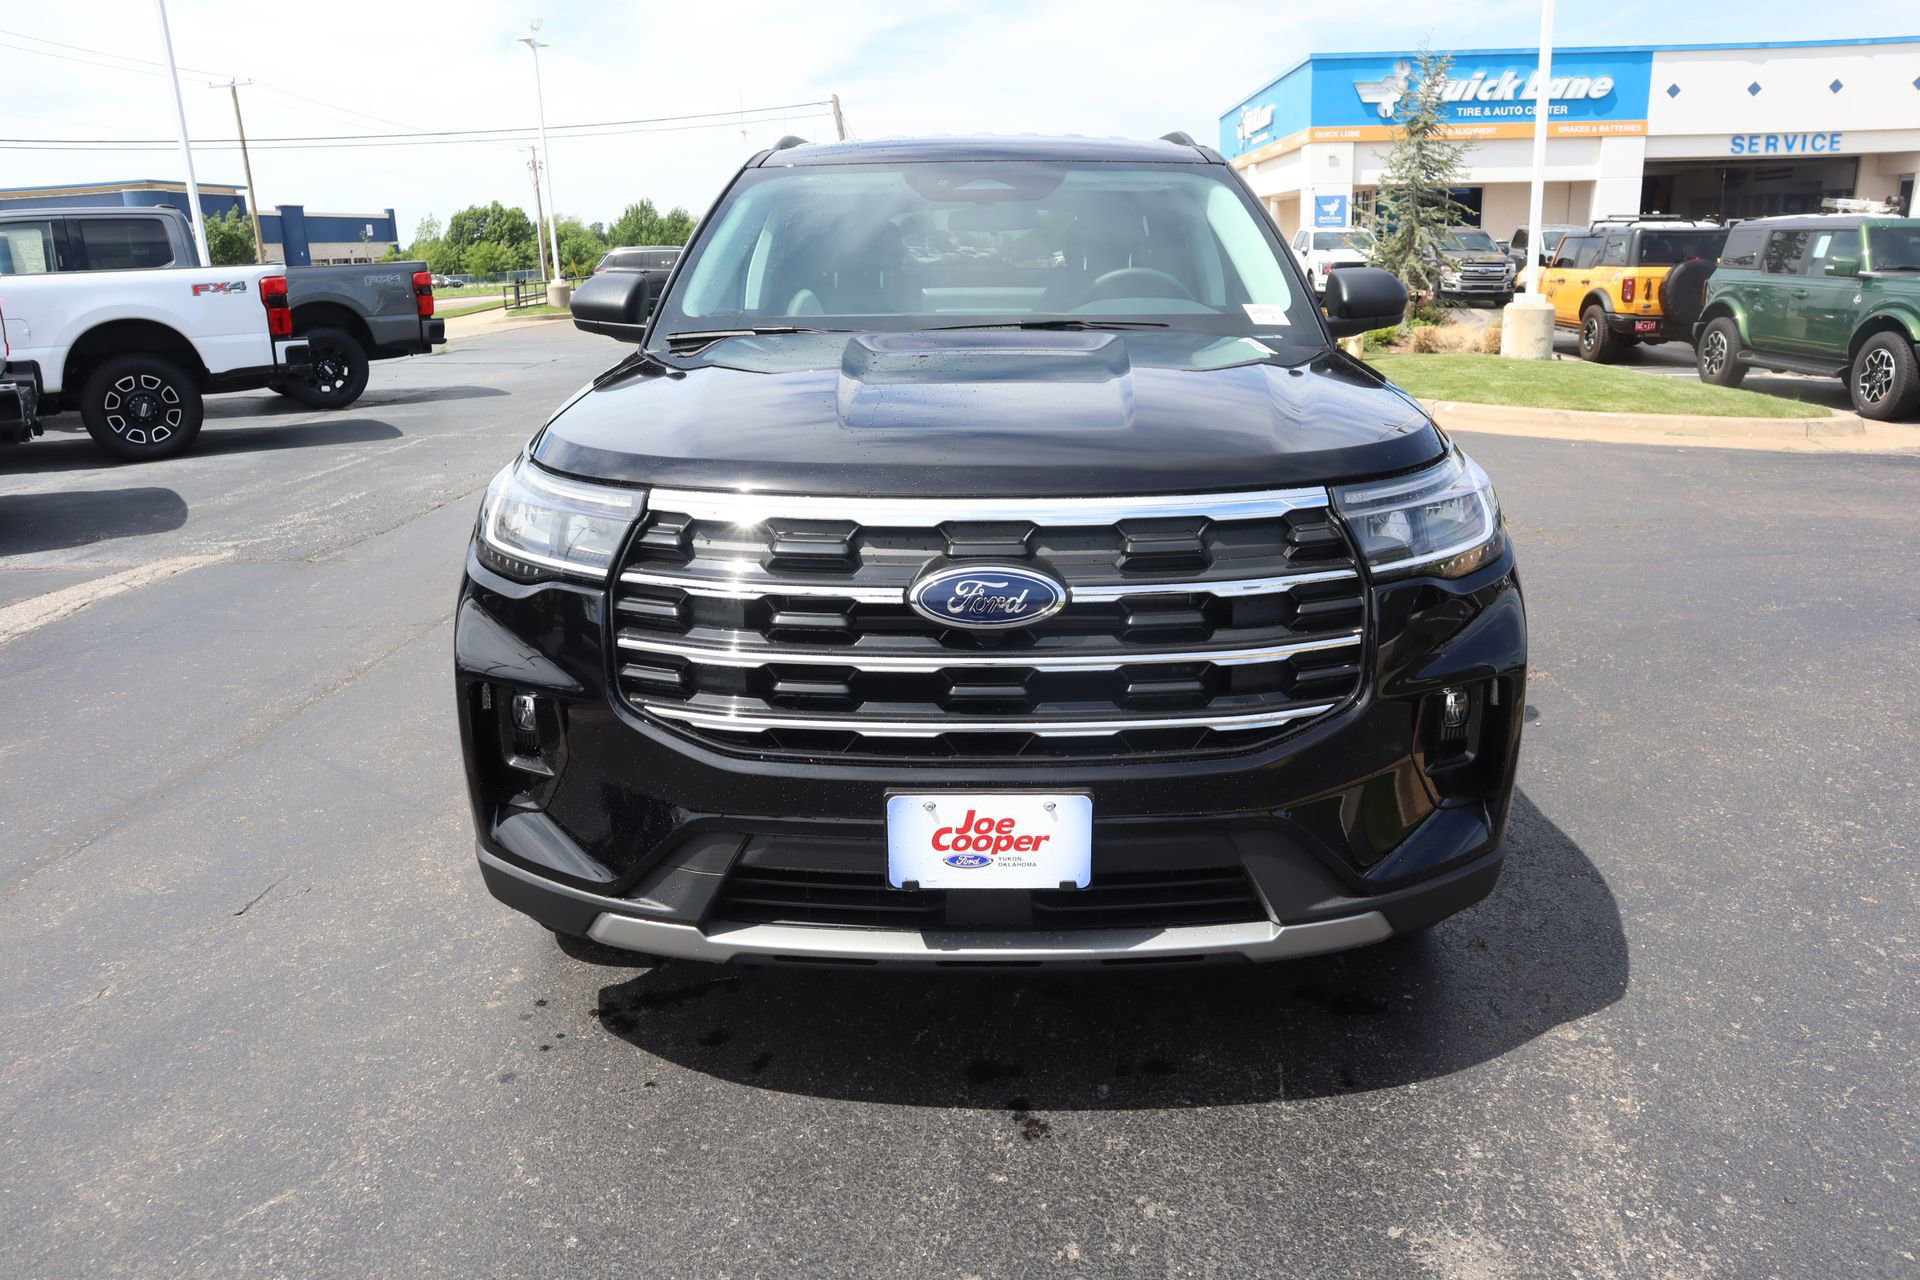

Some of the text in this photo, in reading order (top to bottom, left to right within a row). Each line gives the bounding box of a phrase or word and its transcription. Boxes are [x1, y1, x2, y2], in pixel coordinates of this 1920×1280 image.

[1456, 105, 1569, 117] TIRE & AUTO CETER
[1557, 125, 1590, 134] BRAKES
[1598, 124, 1642, 133] BATTERIES
[1730, 133, 1843, 154] SERVICE
[191, 280, 248, 297] FX4
[946, 579, 1029, 614] Ford
[955, 809, 1016, 835] Joe
[931, 827, 1051, 855] Cooper
